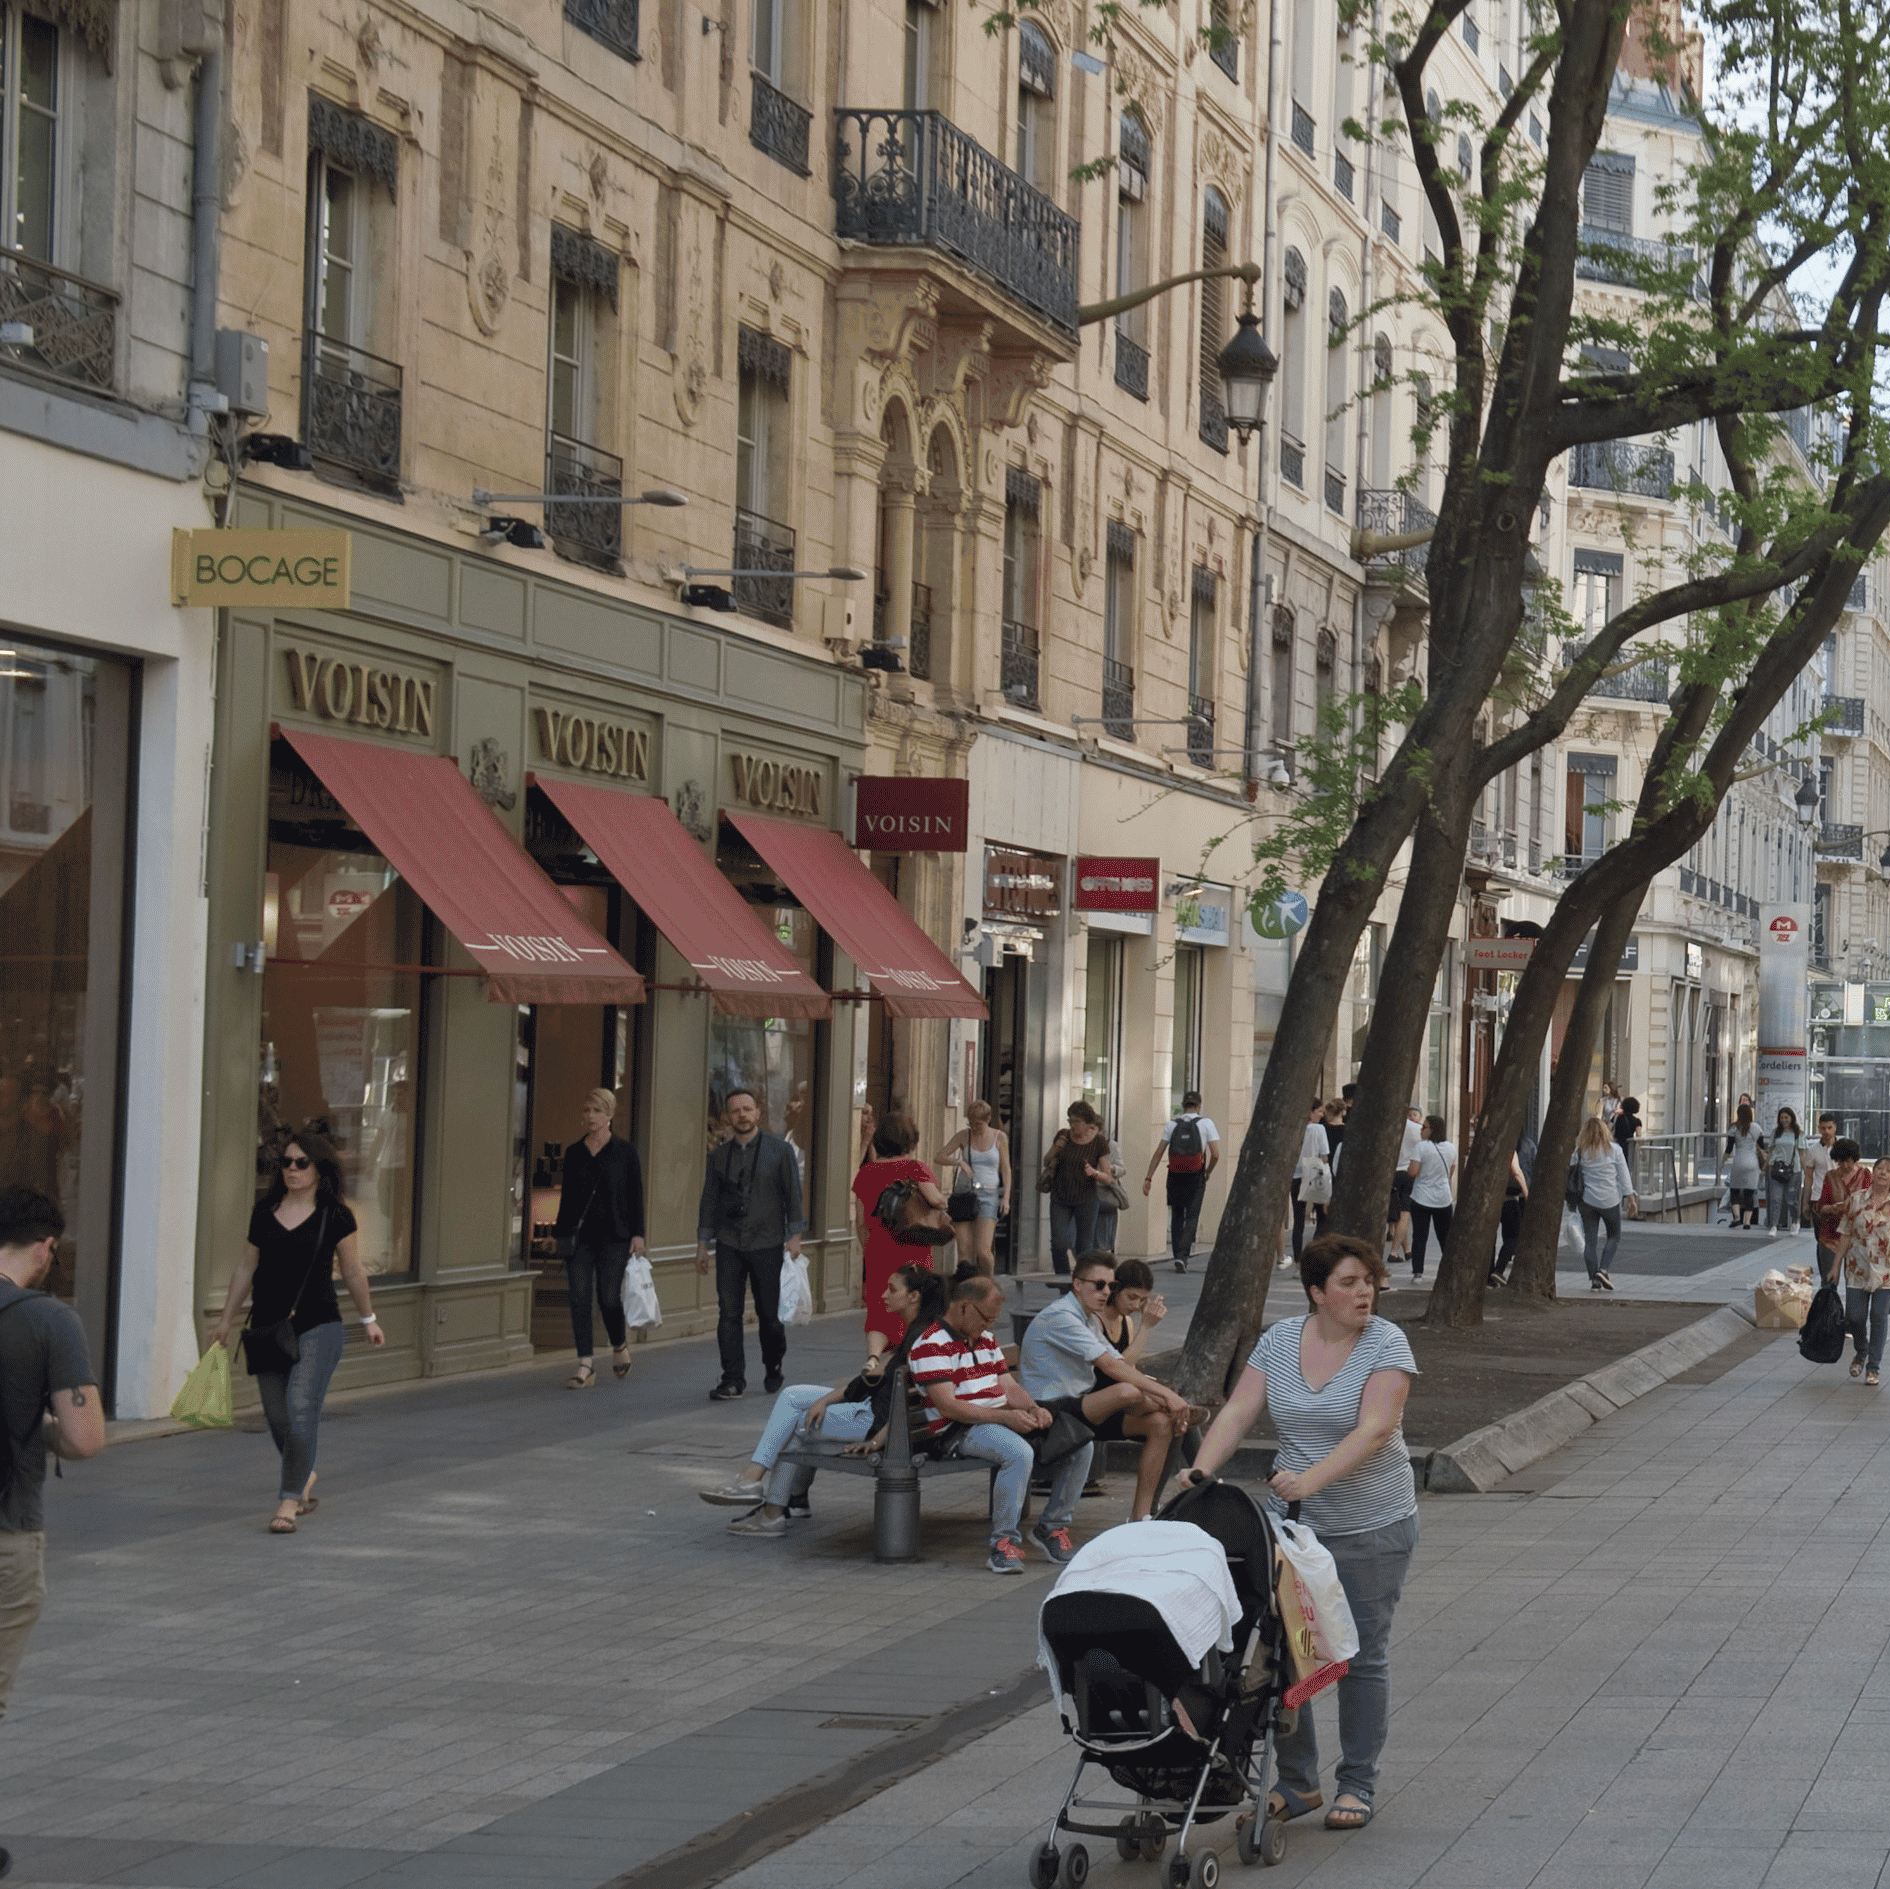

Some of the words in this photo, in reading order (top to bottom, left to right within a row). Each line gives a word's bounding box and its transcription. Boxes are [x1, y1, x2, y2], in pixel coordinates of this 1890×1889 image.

[196, 554, 339, 587] BOCAGE
[287, 649, 437, 736] VOISIN
[538, 707, 651, 781] VOISIN
[735, 754, 822, 816] VOISIN
[865, 815, 951, 834] VOISIN
[486, 932, 583, 962] VOISIN
[1474, 949, 1495, 958] Foot
[1496, 949, 1529, 959] Locker
[706, 954, 783, 983] VOISIN
[880, 966, 941, 990] VOISIN
